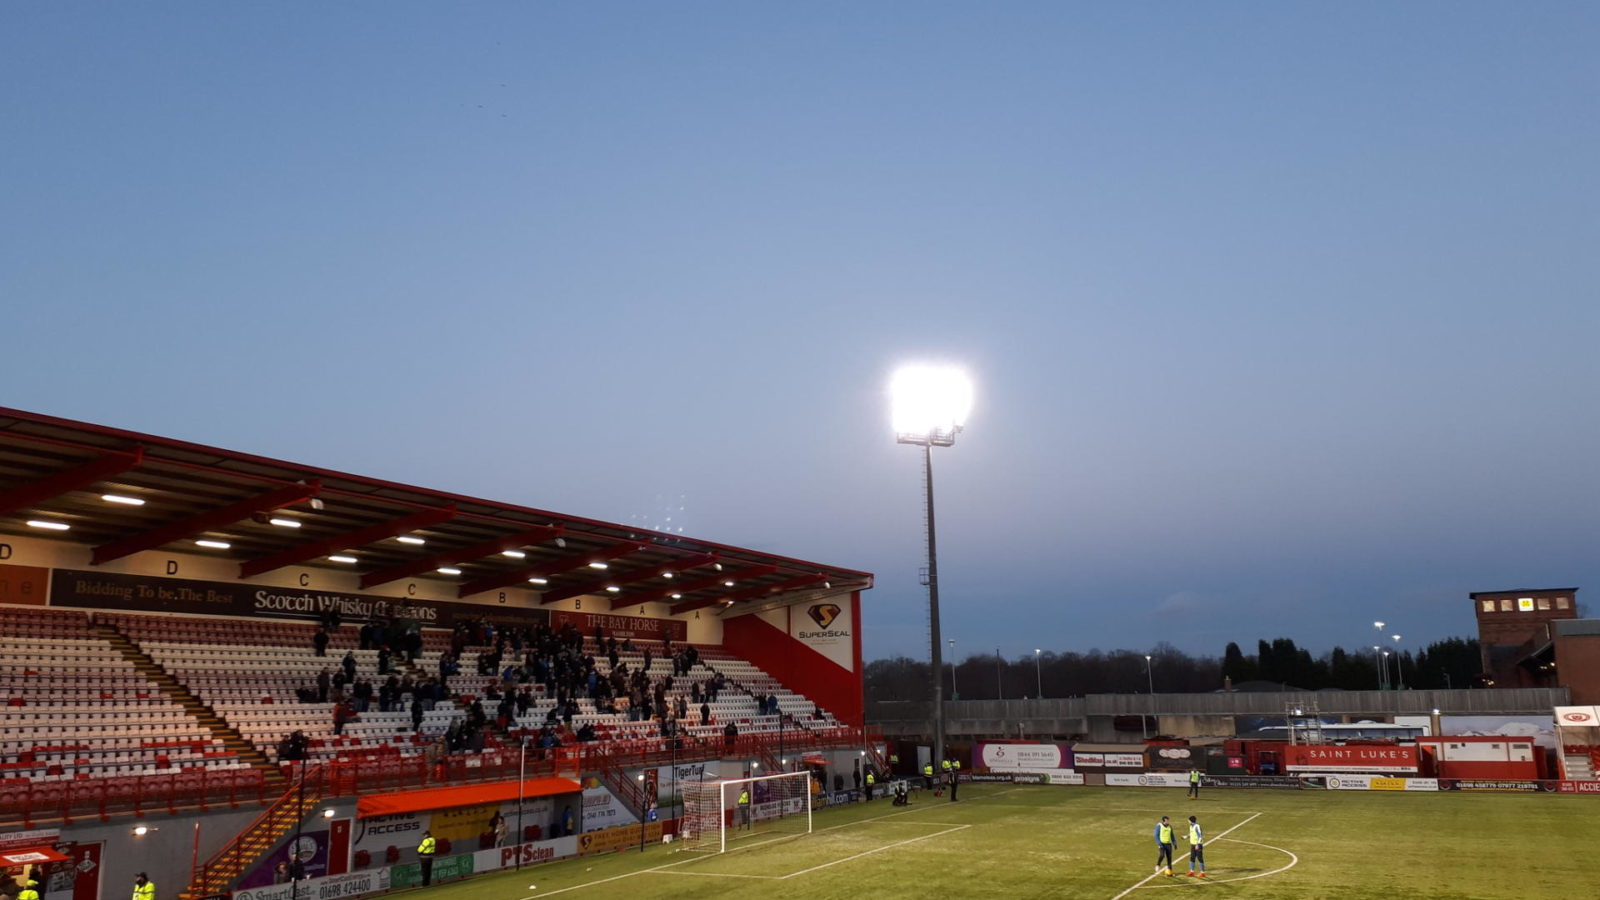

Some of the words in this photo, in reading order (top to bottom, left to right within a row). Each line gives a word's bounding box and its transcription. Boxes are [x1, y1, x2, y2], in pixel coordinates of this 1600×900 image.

[166, 560, 178, 575] D
[299, 573, 310, 587] C
[75, 580, 134, 601] Bidding
[137, 584, 154, 598] To
[178, 588, 203, 602] The
[206, 590, 234, 604] Best
[407, 583, 417, 596] C
[254, 590, 314, 612] Scotch
[317, 594, 373, 620] Whisky
[499, 592, 506, 604] B
[575, 599, 581, 610] B
[639, 605, 646, 615] A
[695, 610, 700, 620] A
[586, 614, 606, 629] THE
[608, 616, 628, 631] BAY
[629, 618, 660, 632] HORSE
[1310, 750, 1352, 758] SAINT
[1360, 750, 1409, 759] LUKE'S
[674, 763, 705, 780] TigerTurf
[368, 821, 420, 835] ACCESS
[319, 884, 342, 900] 01698
[344, 878, 371, 894] 424400
